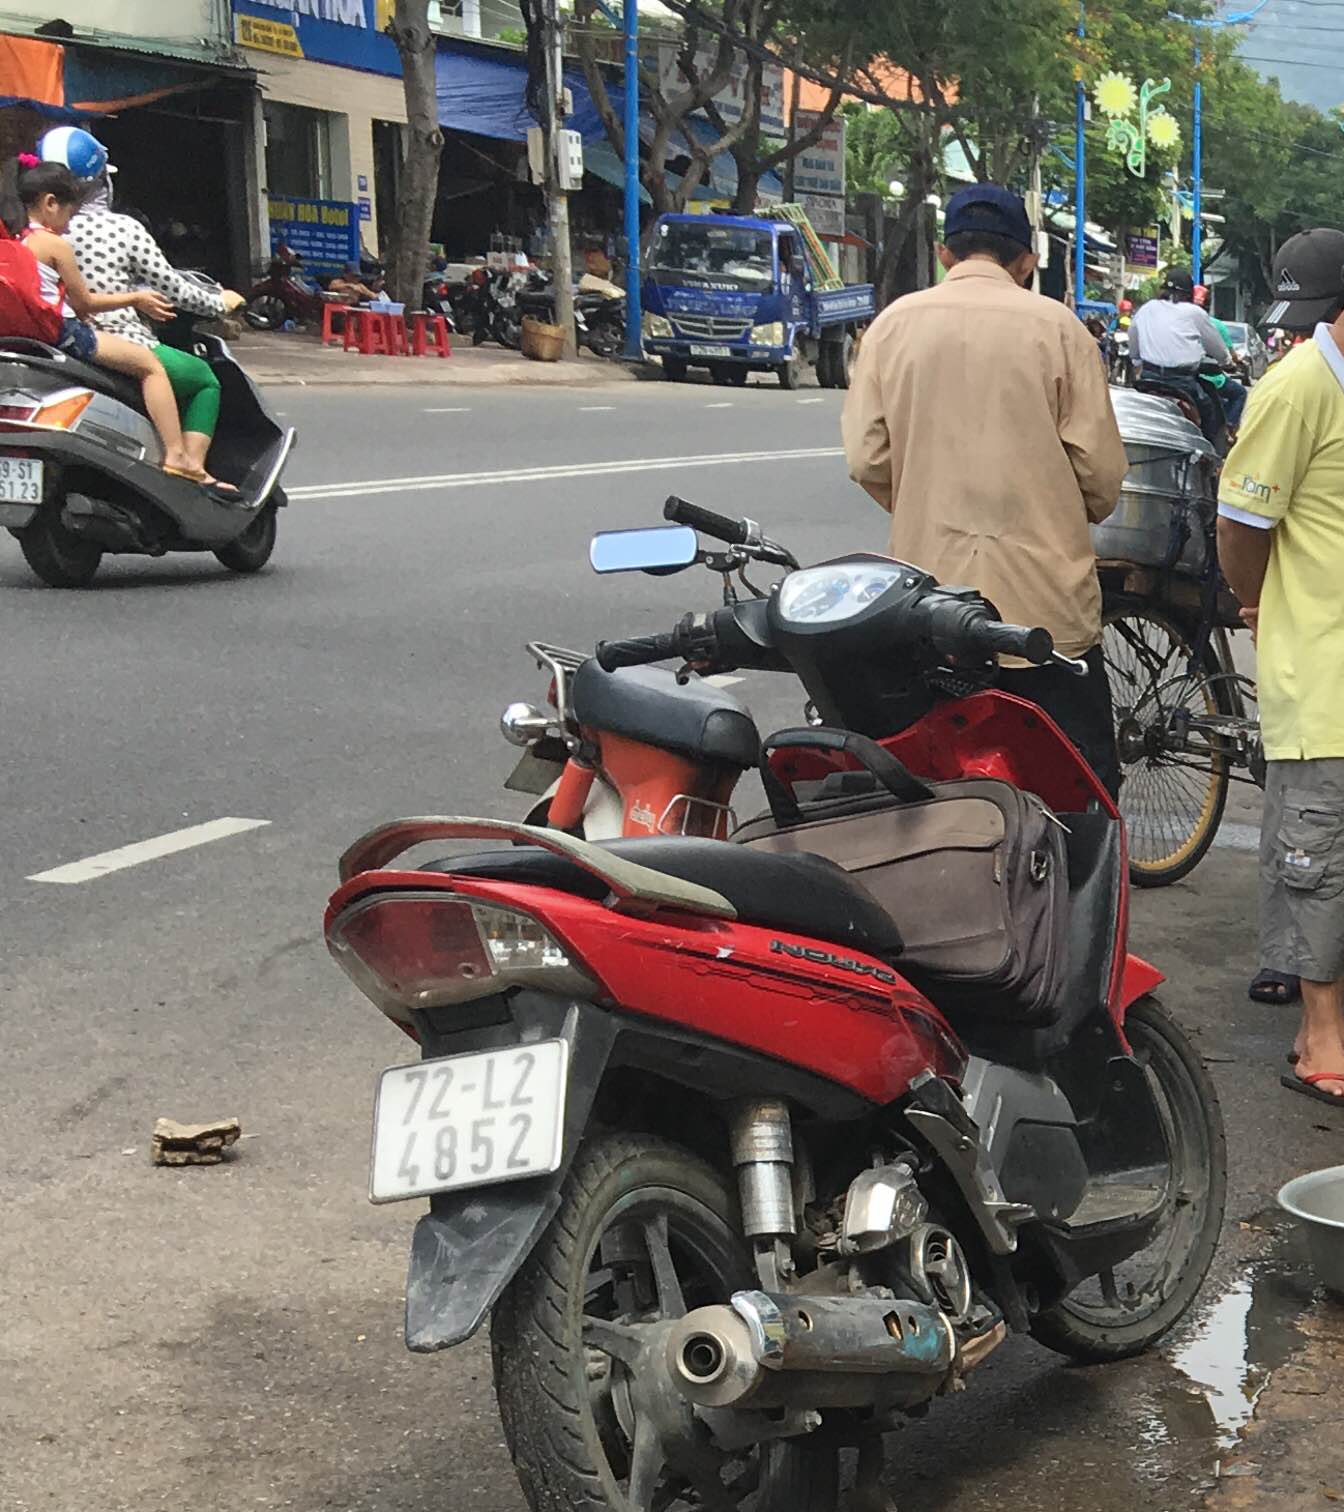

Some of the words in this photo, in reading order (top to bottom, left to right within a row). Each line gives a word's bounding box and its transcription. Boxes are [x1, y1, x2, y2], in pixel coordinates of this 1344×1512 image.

[0, 460, 33, 479] 9-S1
[402, 1052, 536, 1126] 72-L2
[397, 1112, 533, 1187] 4852
